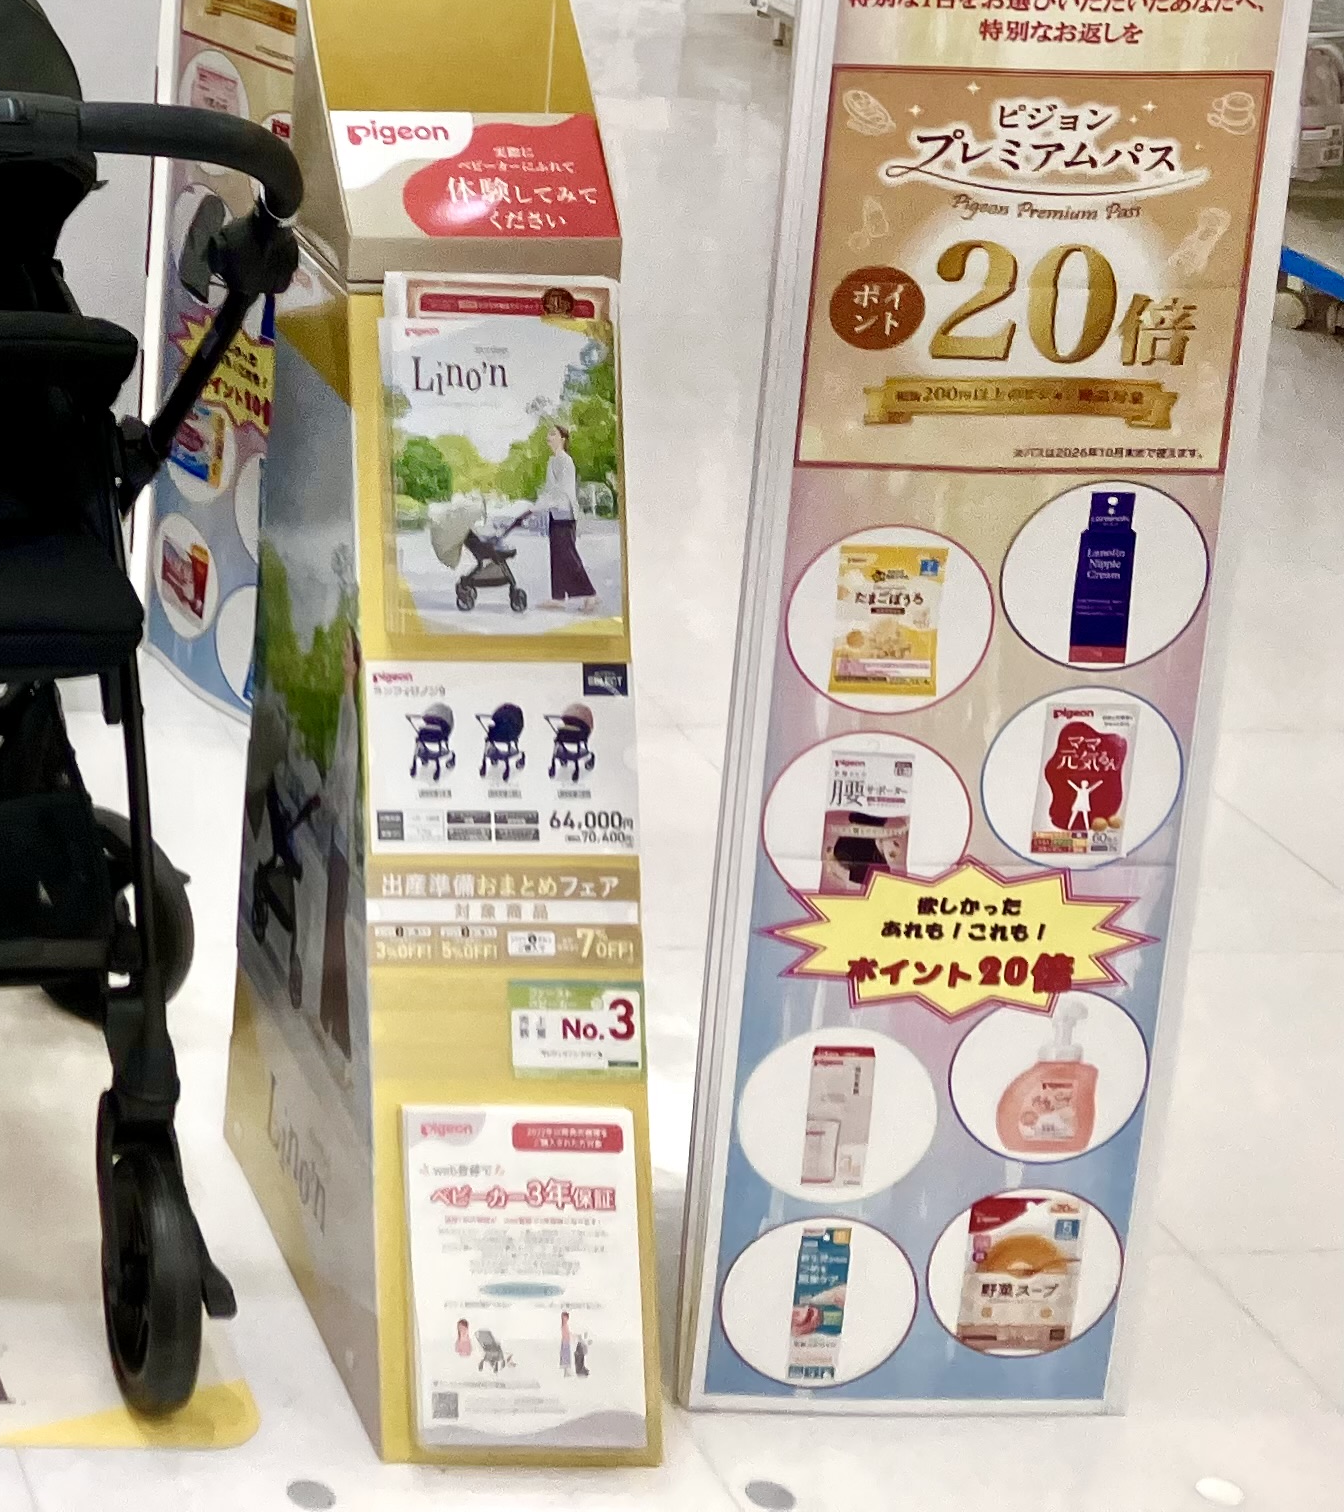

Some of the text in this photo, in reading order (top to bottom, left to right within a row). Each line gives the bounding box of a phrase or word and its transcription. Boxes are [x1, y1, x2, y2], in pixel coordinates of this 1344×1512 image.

[978, 18, 1144, 44] 特別なお返しを
[997, 104, 1114, 132] ピジョン
[347, 119, 449, 145] pigeon
[915, 128, 1177, 173] プレミアムパス
[445, 175, 599, 206] 体験してみて
[488, 209, 568, 231] ください
[952, 192, 1010, 220] Pigeon
[1017, 200, 1098, 221] Premium
[928, 239, 1198, 367] 20倍
[1053, 707, 1095, 720] pigeon
[1067, 736, 1102, 751] ママ
[916, 896, 1023, 917] 欲しかった
[845, 953, 1076, 995] ポイント20倍
